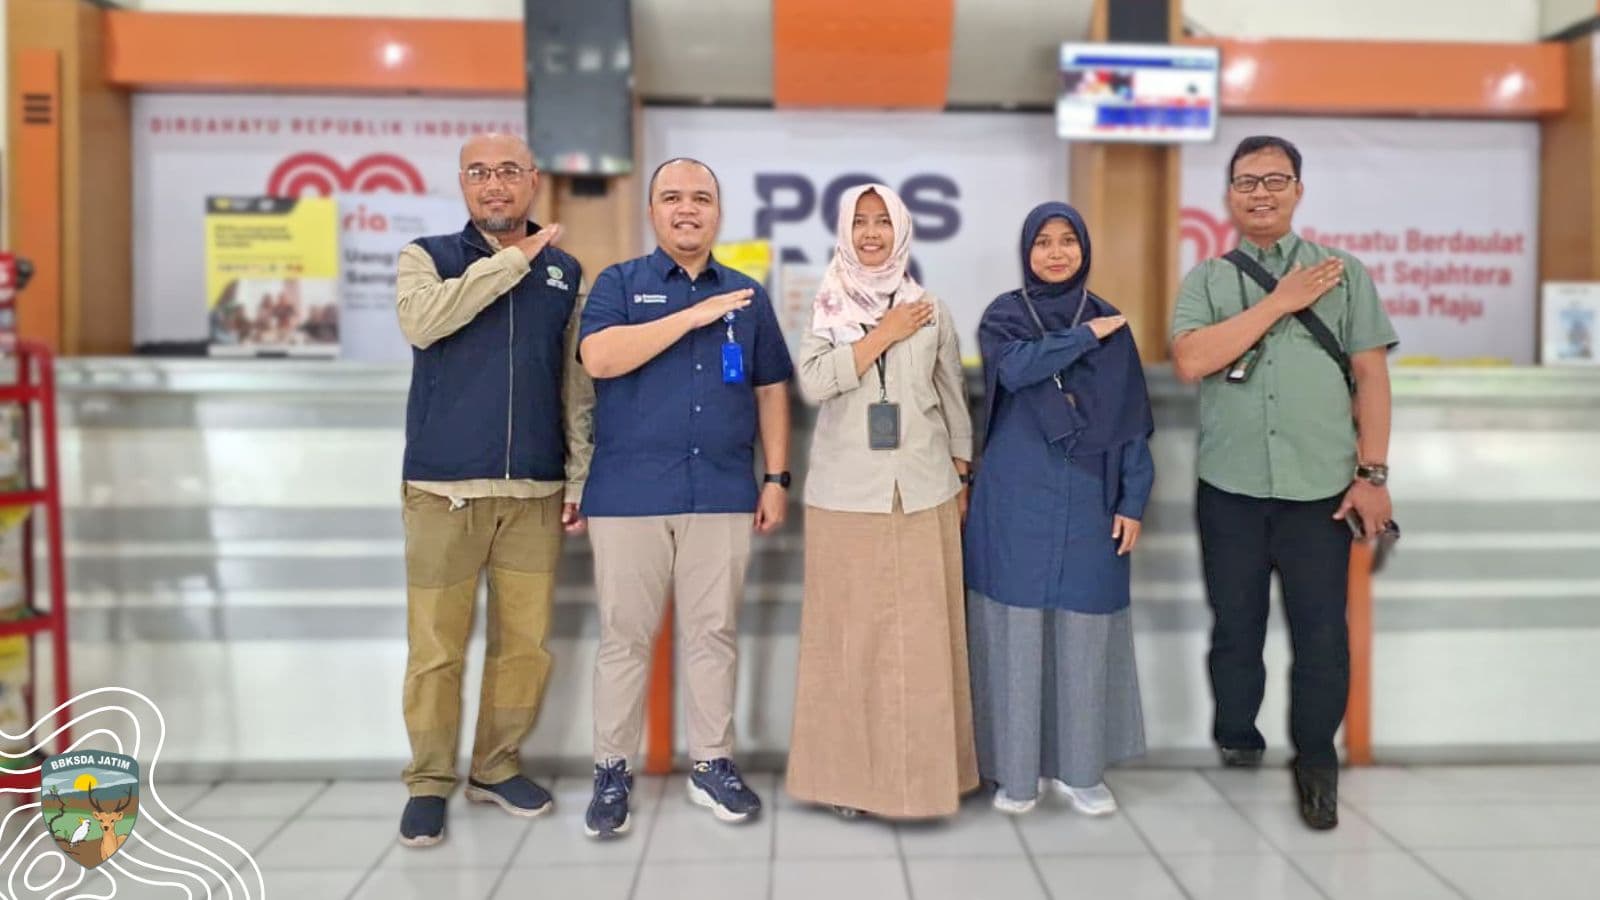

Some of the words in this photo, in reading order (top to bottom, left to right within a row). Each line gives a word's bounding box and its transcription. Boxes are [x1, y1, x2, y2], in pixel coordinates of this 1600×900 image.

[291, 117, 402, 136] REPUBLIK
[1405, 229, 1525, 254] Berdaulat
[1393, 261, 1512, 289] Sejahtera
[1427, 295, 1484, 322] Maju
